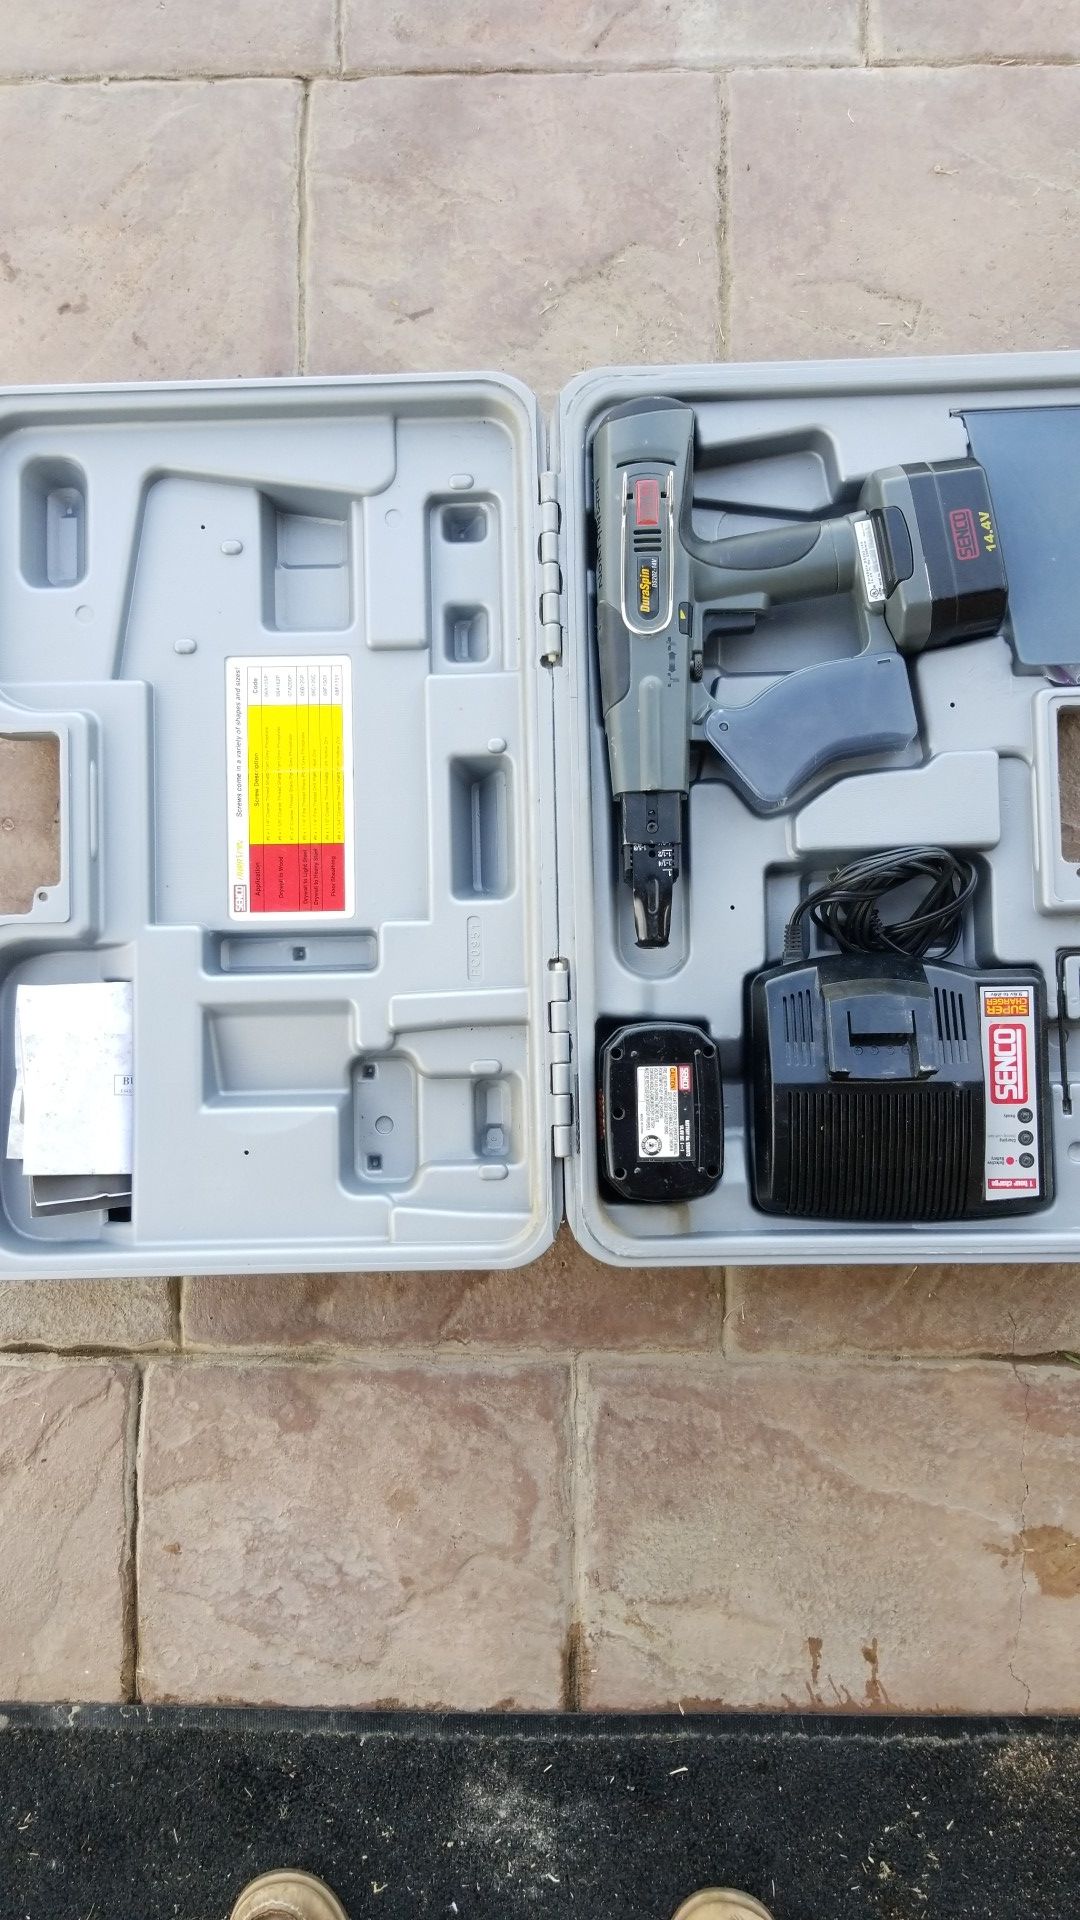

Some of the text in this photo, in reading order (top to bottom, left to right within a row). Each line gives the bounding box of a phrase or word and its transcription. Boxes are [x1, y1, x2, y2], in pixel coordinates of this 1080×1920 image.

[953, 512, 972, 558] SENCO
[979, 511, 997, 552] 14.4V
[640, 568, 651, 612] DuraSpin
[987, 1005, 1028, 1015] SUPER
[993, 1028, 1017, 1100] SENCO
